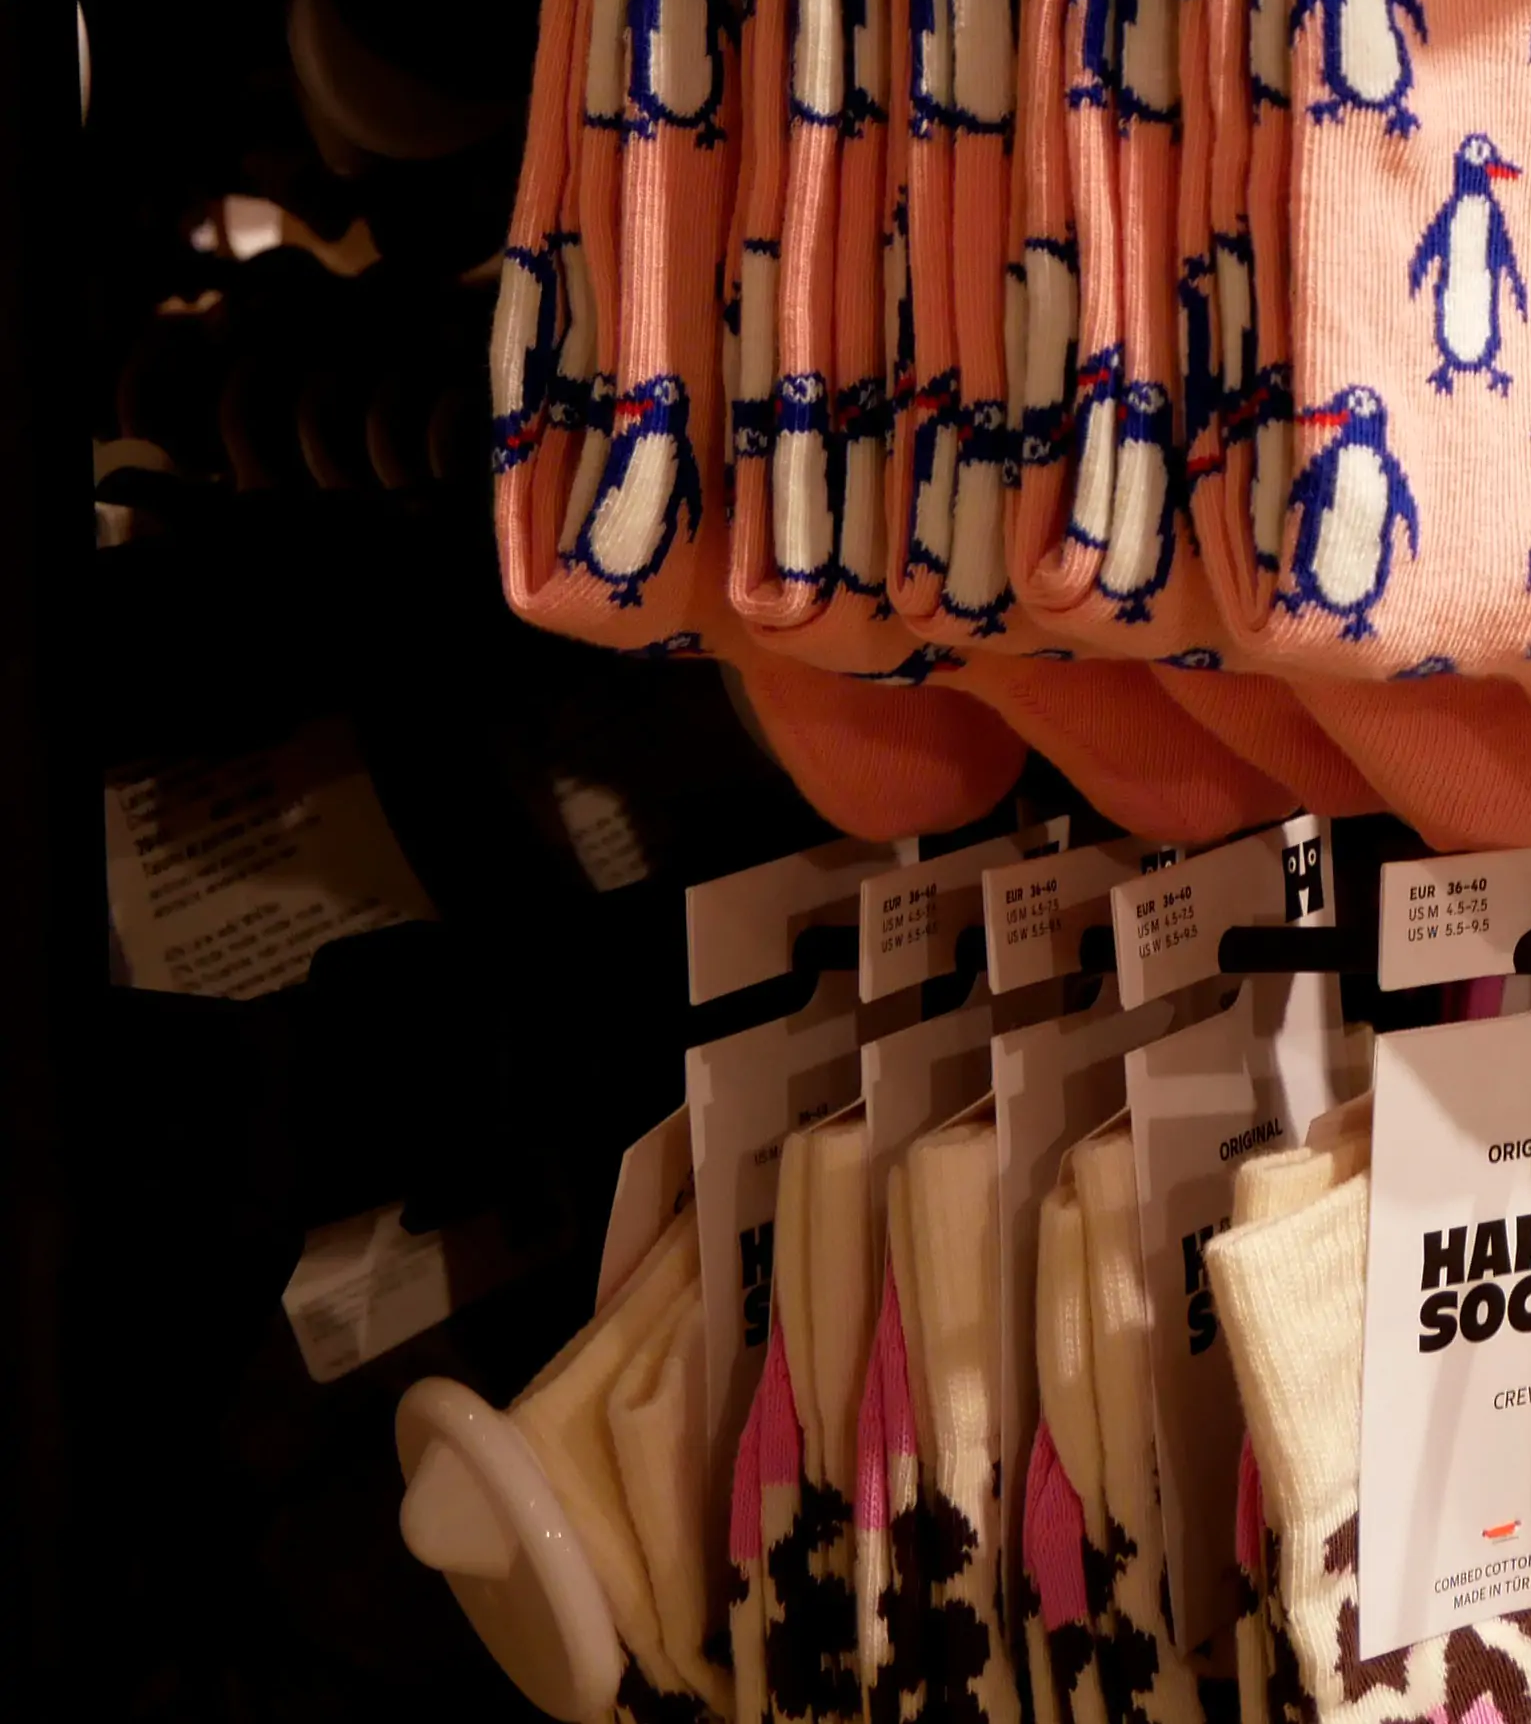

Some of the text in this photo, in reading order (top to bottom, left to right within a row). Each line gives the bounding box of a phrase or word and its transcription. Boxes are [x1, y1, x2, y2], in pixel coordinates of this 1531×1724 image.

[1006, 888, 1023, 904] EUR
[1410, 878, 1487, 901] EUR 36-40
[883, 895, 901, 913] EUR
[1136, 886, 1192, 918] EUR 36-40
[1409, 899, 1488, 921] US M 4.5-7.5
[1137, 922, 1148, 938] US
[1149, 918, 1159, 934] M
[1408, 919, 1490, 942] US W 5.5-9.5
[1139, 942, 1151, 958] US
[1152, 938, 1161, 954] W
[1220, 1118, 1282, 1162] ORIGINAL
[1435, 1569, 1482, 1593] COMBED
[1453, 1588, 1487, 1609] MADE
[1489, 1583, 1501, 1599] IN
